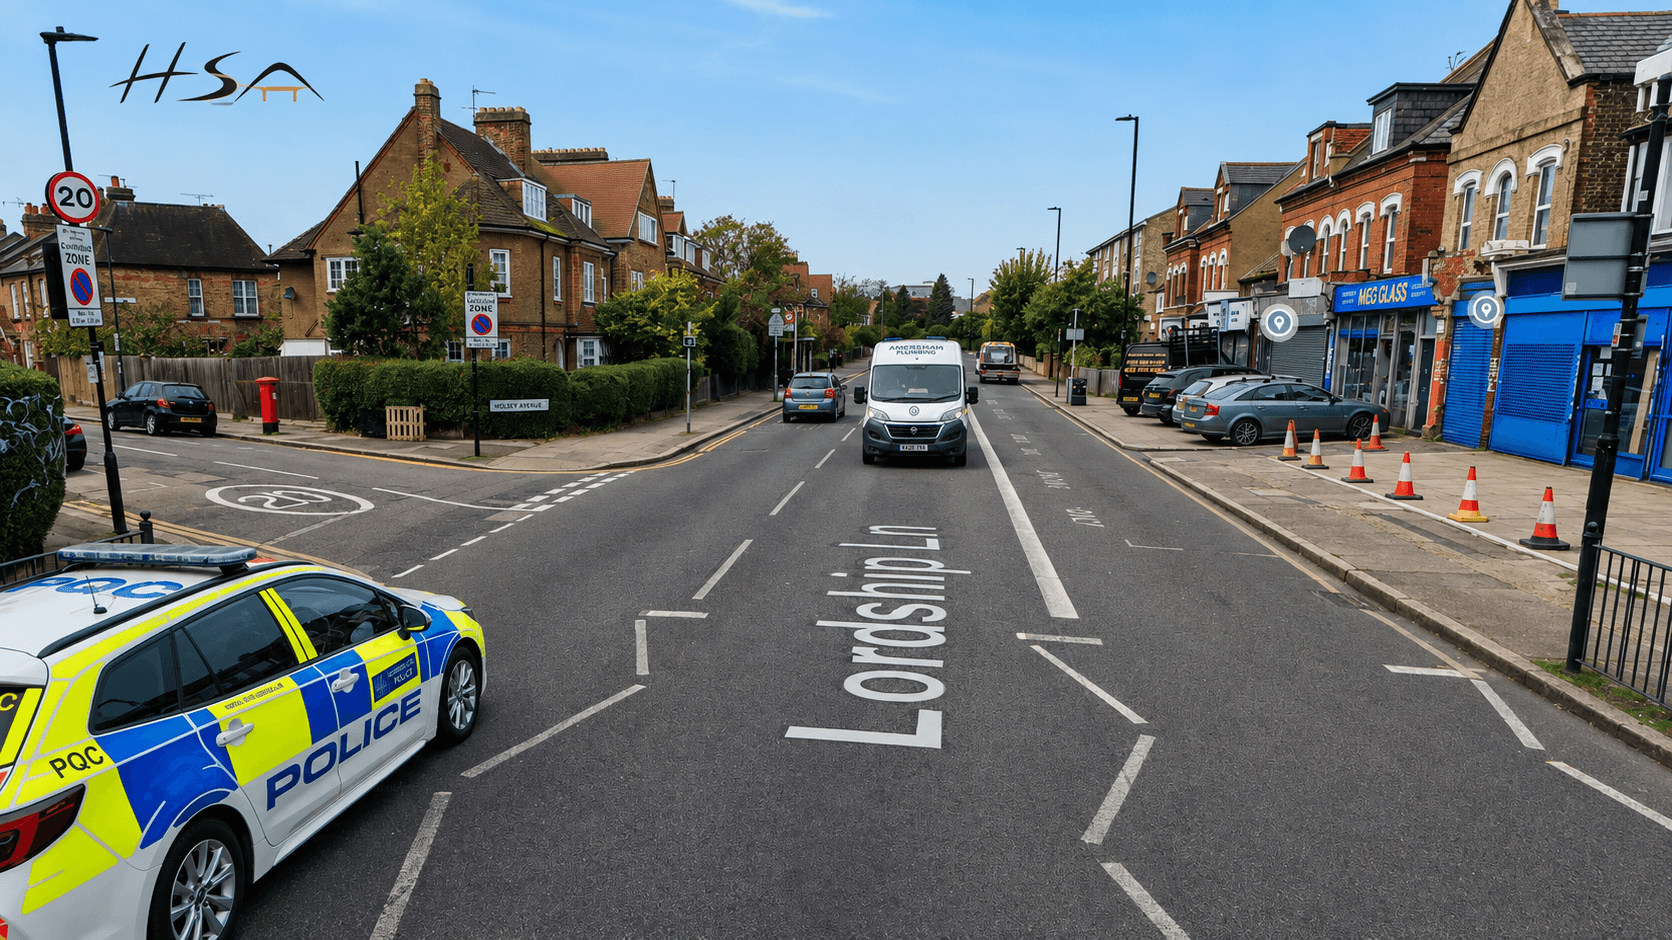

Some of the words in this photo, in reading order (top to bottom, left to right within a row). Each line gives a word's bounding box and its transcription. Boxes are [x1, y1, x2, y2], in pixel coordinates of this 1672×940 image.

[58, 186, 93, 209] 20
[65, 253, 91, 266] ZONE
[1378, 282, 1408, 304] GLASS
[469, 304, 493, 312] ZONE
[5, 577, 183, 599] PQC
[267, 688, 421, 812] POLICE
[49, 746, 104, 779] PQC
